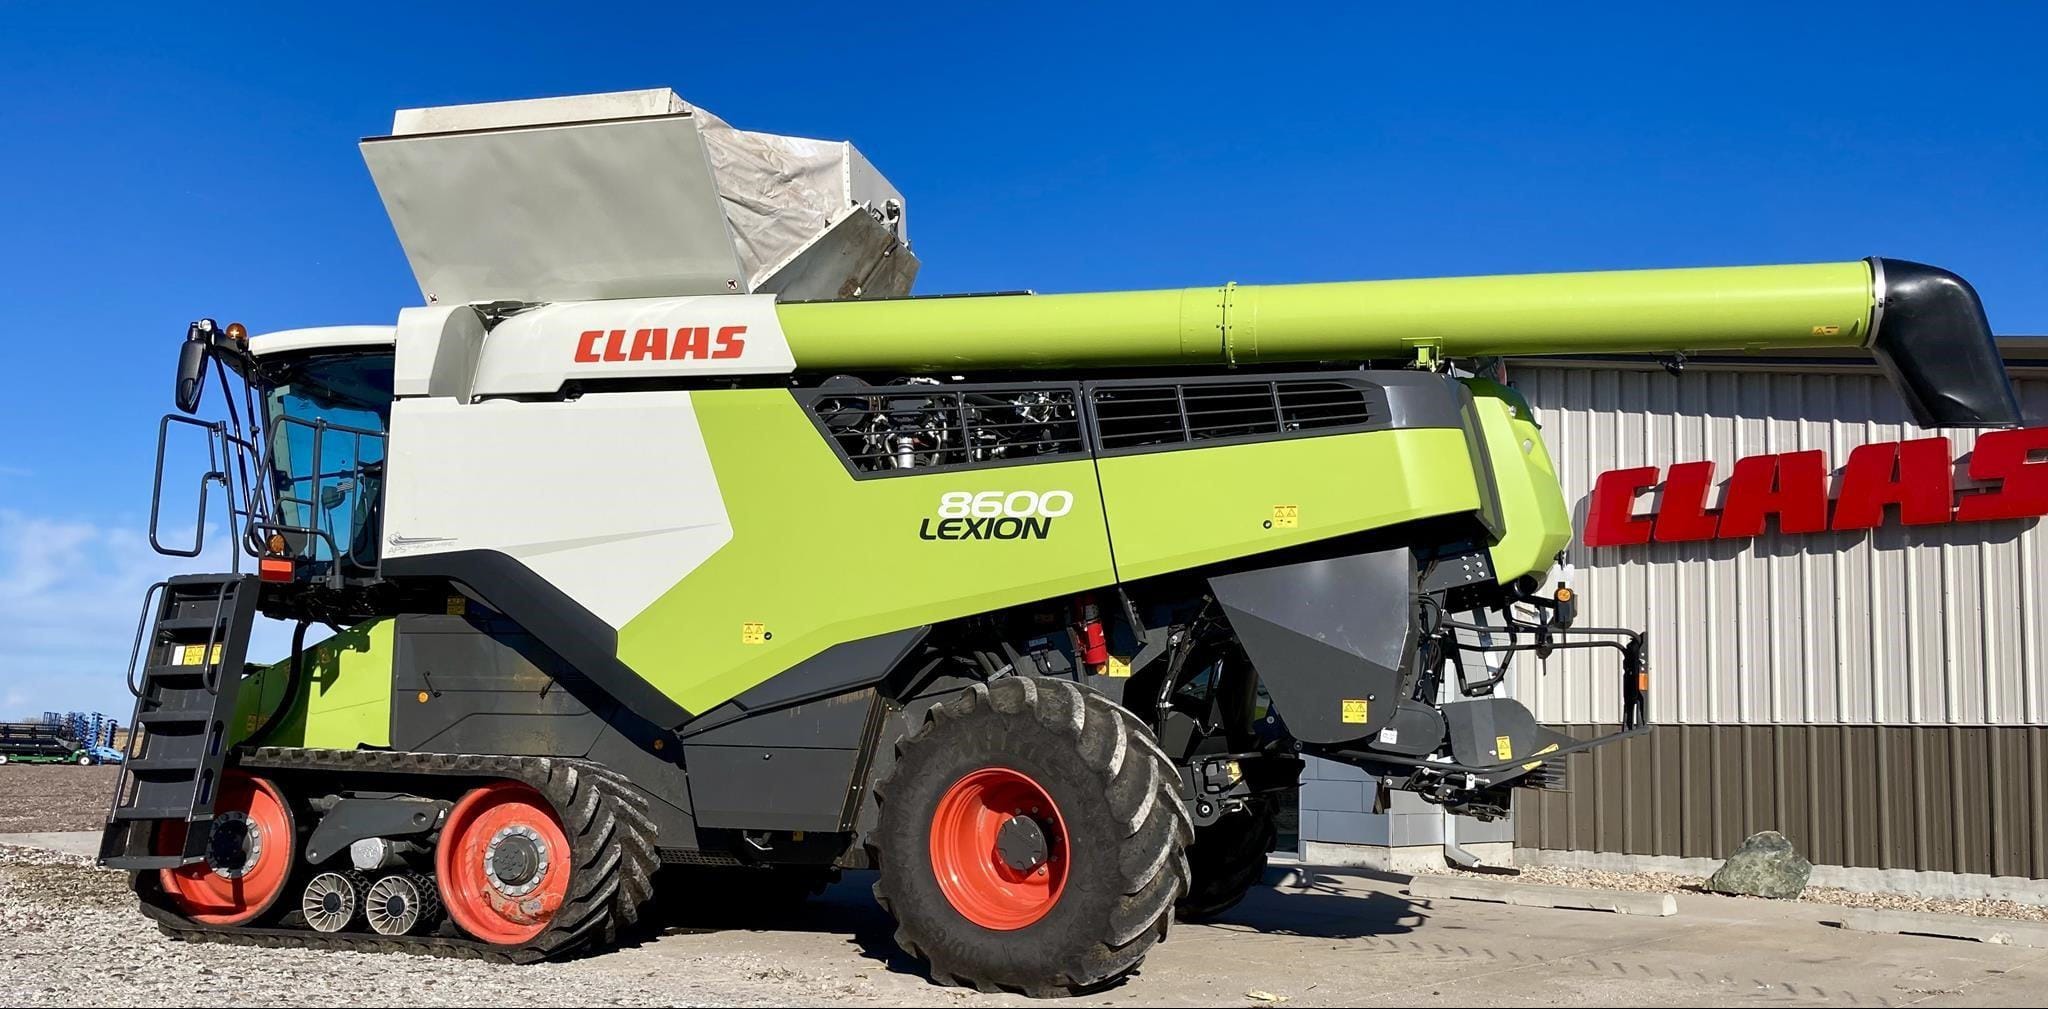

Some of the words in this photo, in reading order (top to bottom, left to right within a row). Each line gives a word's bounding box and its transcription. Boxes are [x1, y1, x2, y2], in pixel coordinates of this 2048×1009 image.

[574, 325, 748, 363] CLAAS
[1583, 427, 2048, 547] CLAAS
[937, 490, 1074, 519] 8600
[919, 517, 1052, 541] LEXION
